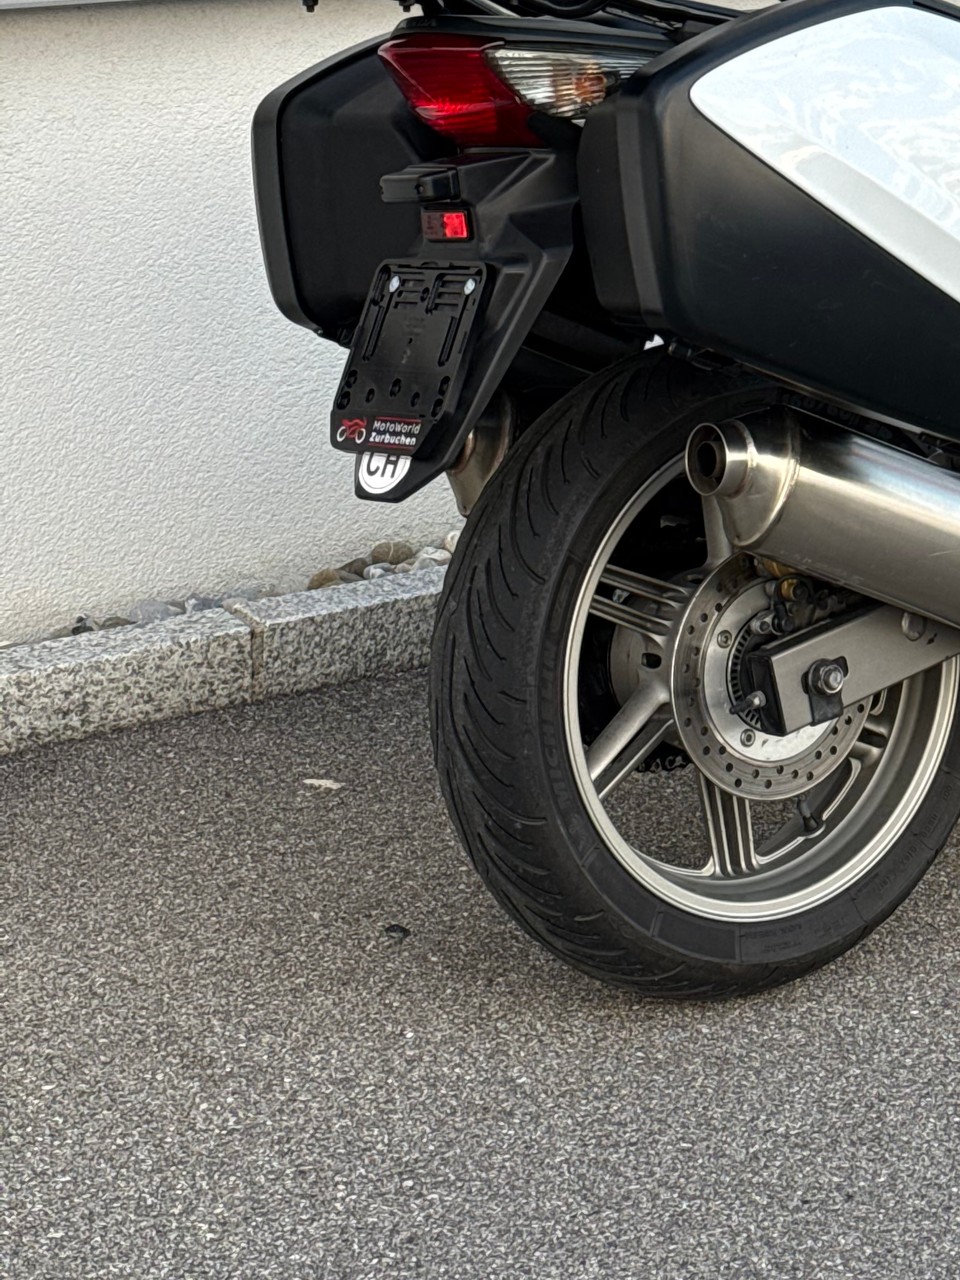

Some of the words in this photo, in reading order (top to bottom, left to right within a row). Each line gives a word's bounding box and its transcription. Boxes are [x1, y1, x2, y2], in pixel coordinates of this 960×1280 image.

[373, 420, 421, 435] MotoWorld
[369, 431, 417, 446] Zurbuchen
[366, 451, 402, 479] CH
